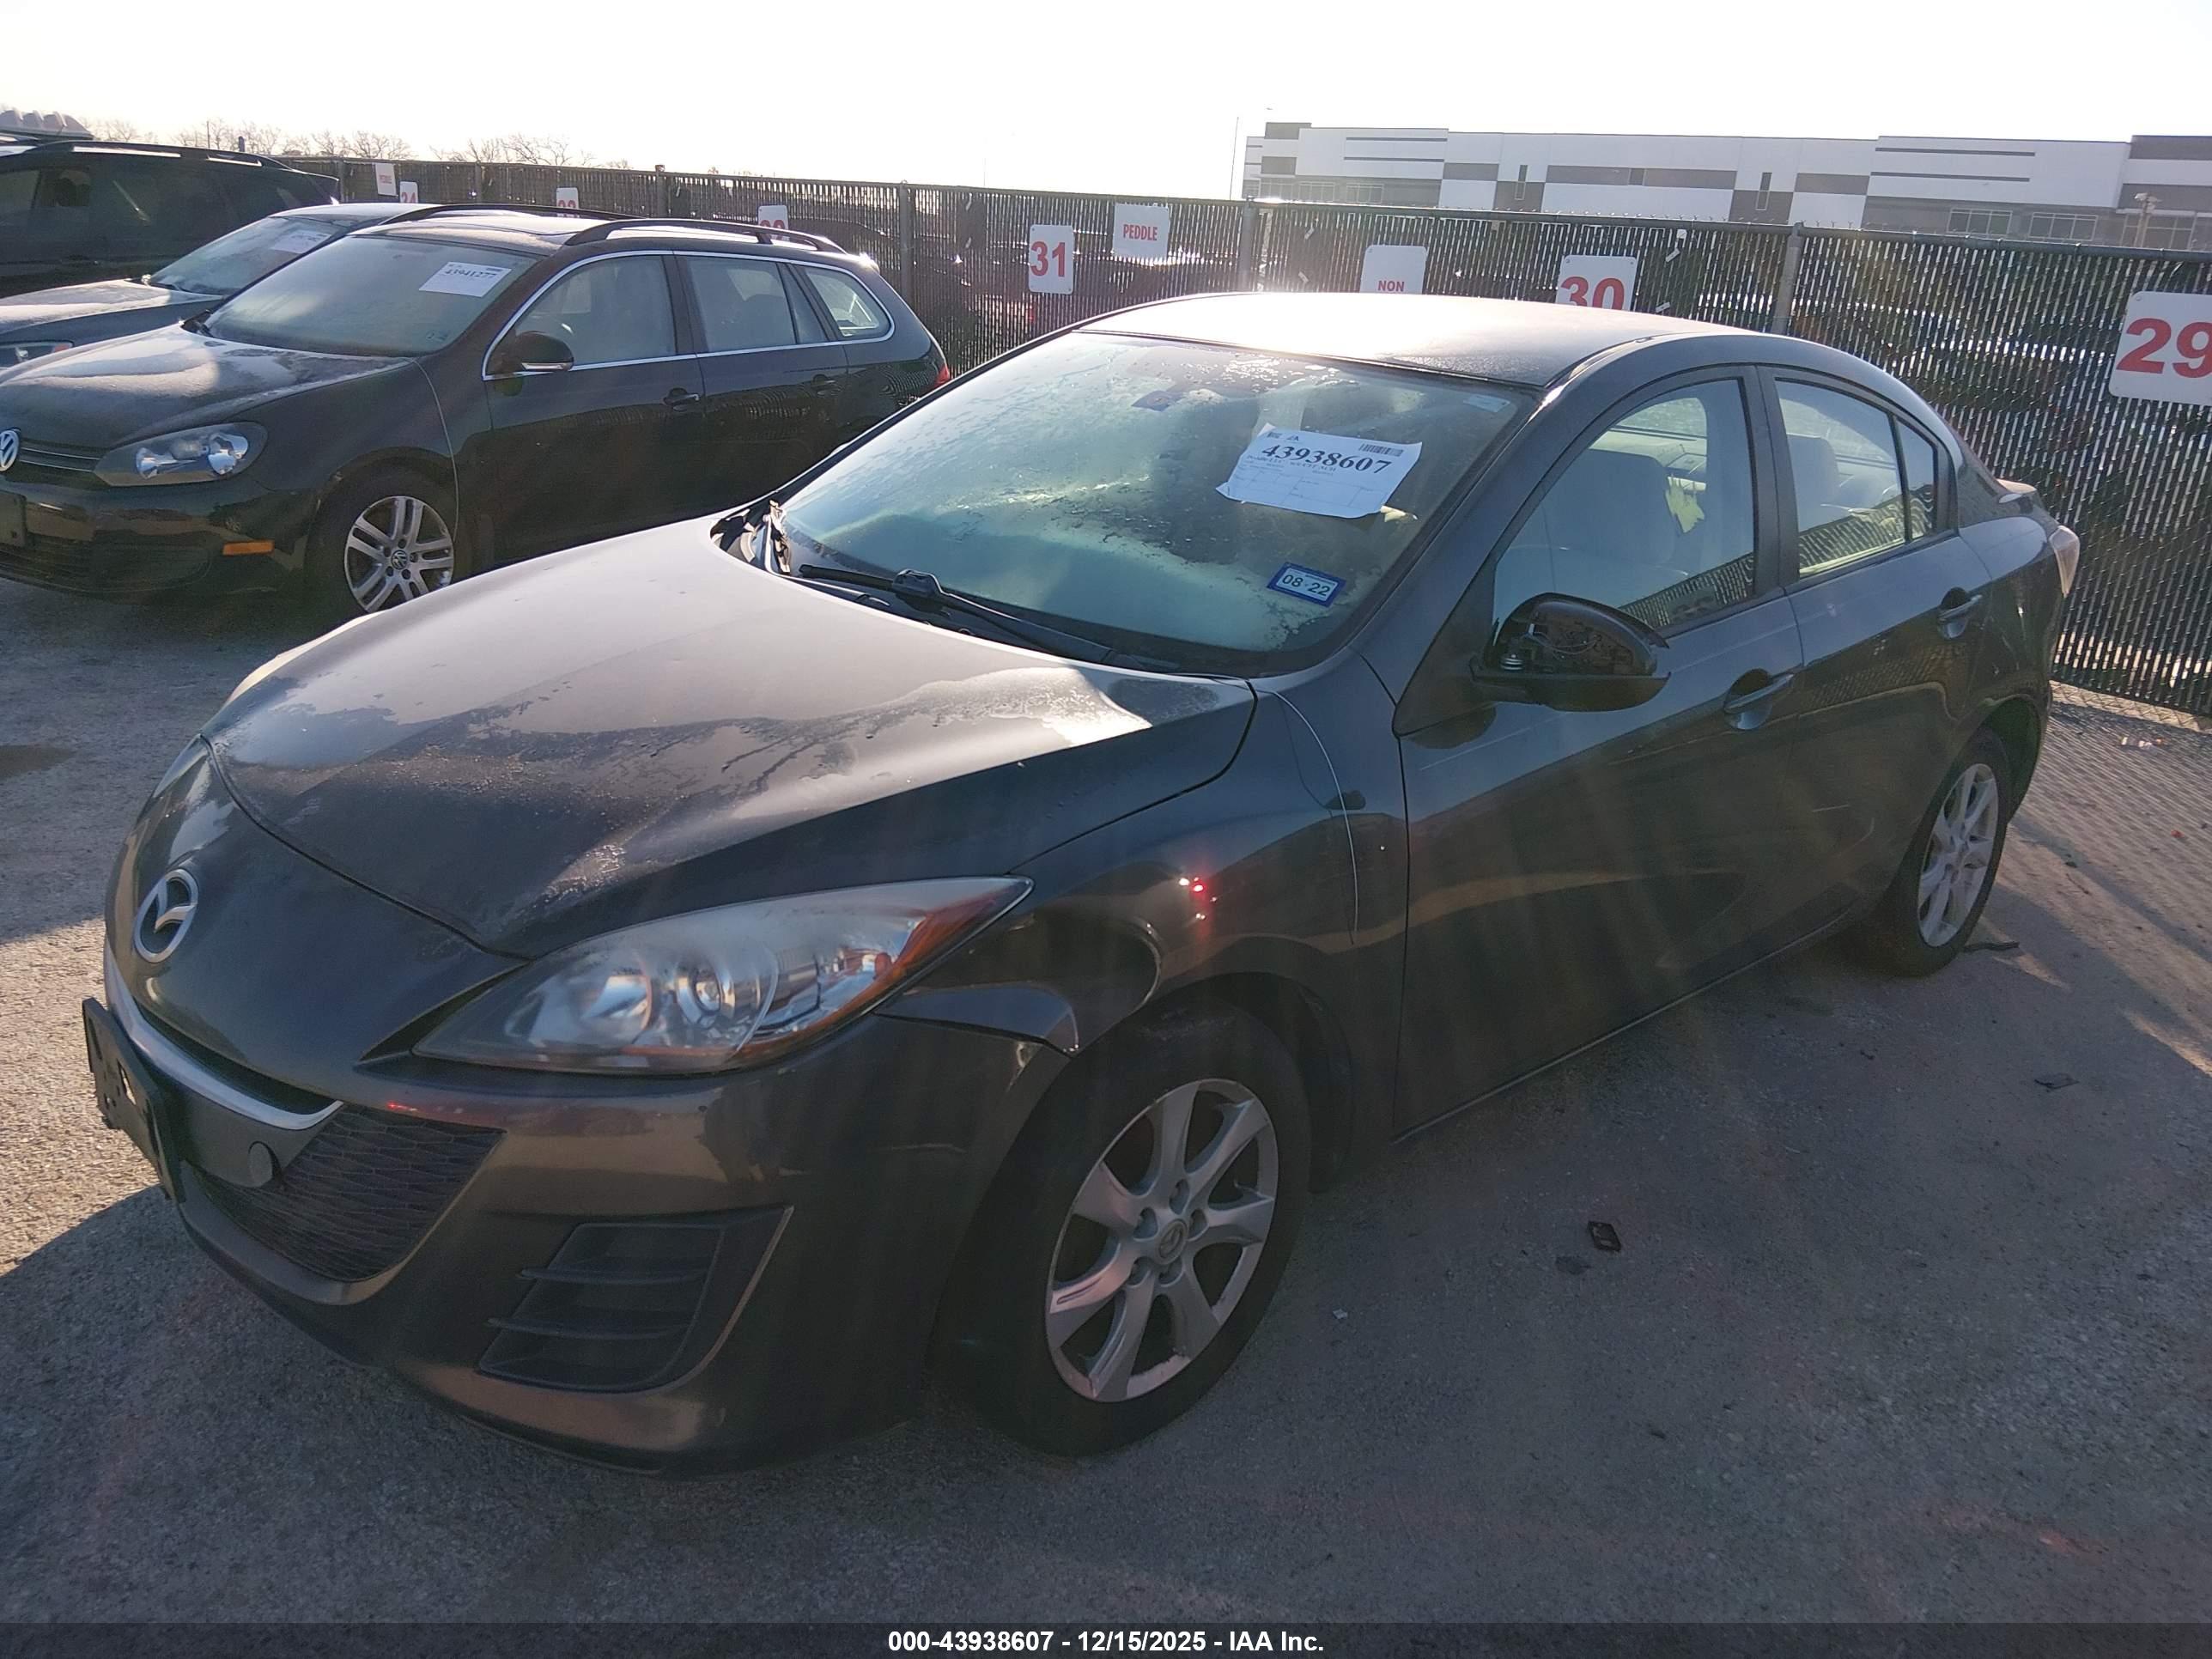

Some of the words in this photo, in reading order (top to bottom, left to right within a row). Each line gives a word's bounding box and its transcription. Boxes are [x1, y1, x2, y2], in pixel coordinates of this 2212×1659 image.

[1122, 223, 1158, 241] PEDDLE
[1030, 240, 1066, 278] 31
[1377, 280, 1406, 293] NON
[1560, 276, 1626, 311] 30
[2115, 317, 2212, 379] 29
[1261, 443, 1393, 474] 43938607
